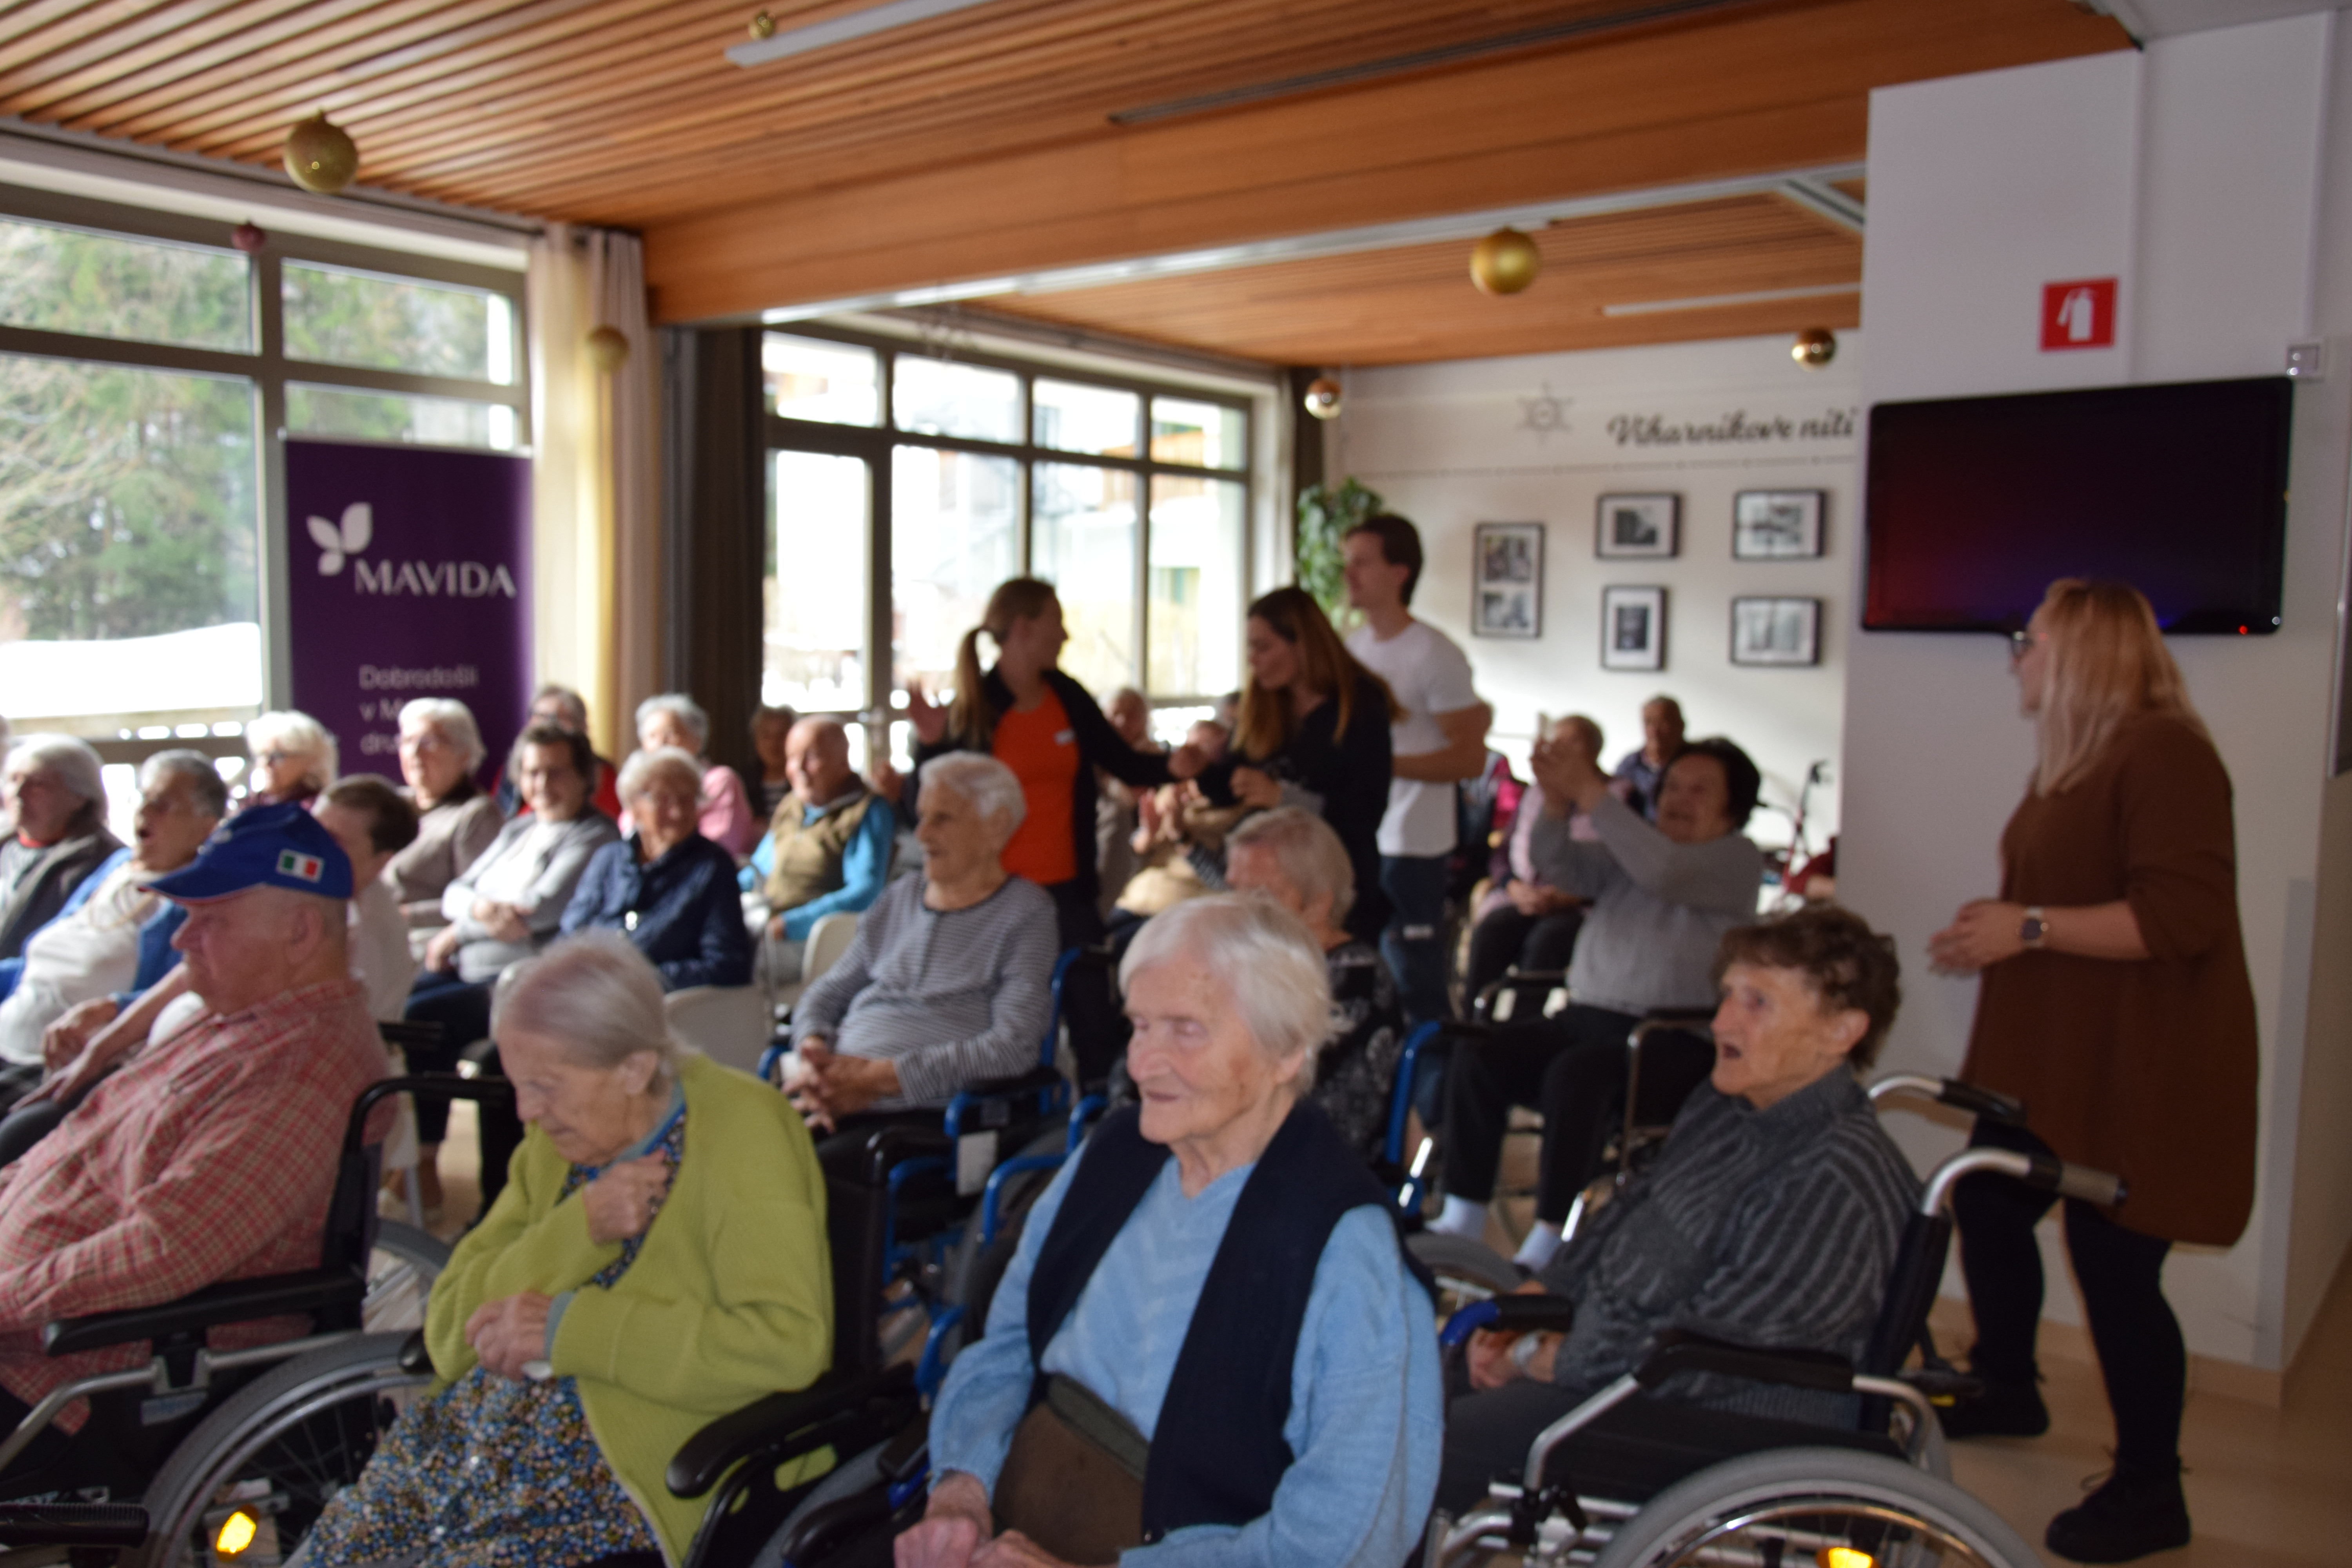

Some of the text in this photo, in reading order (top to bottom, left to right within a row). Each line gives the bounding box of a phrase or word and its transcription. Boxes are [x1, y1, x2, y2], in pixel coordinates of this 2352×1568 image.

[1800, 406, 1859, 439] niti
[354, 558, 517, 599] MAVIDA
[359, 664, 479, 690] Dobrodošli
